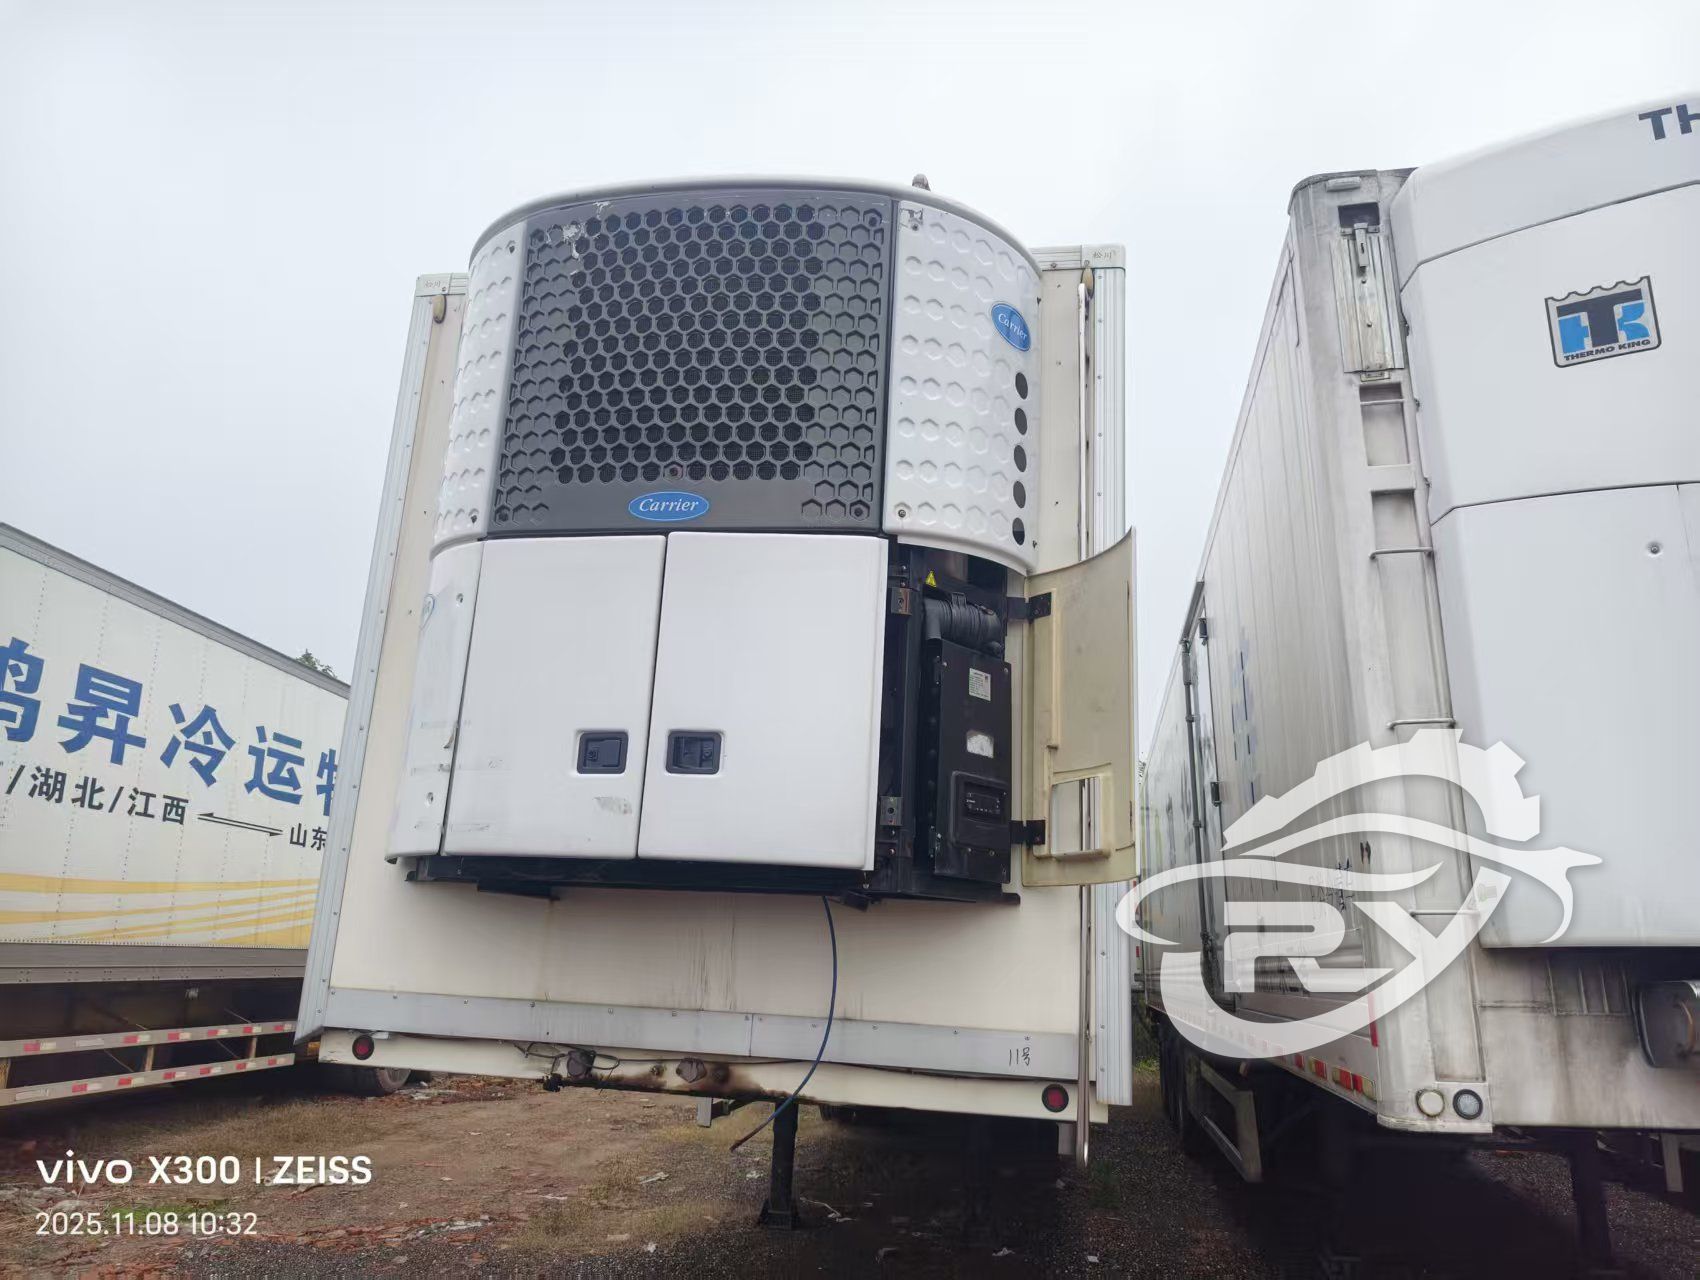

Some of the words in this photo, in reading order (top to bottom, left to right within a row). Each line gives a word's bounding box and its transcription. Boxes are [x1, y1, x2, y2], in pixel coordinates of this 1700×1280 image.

[998, 313, 1028, 339] Carrier
[1564, 346, 1615, 361] THERMO
[1618, 339, 1651, 350] KING
[639, 498, 699, 512] Carrier
